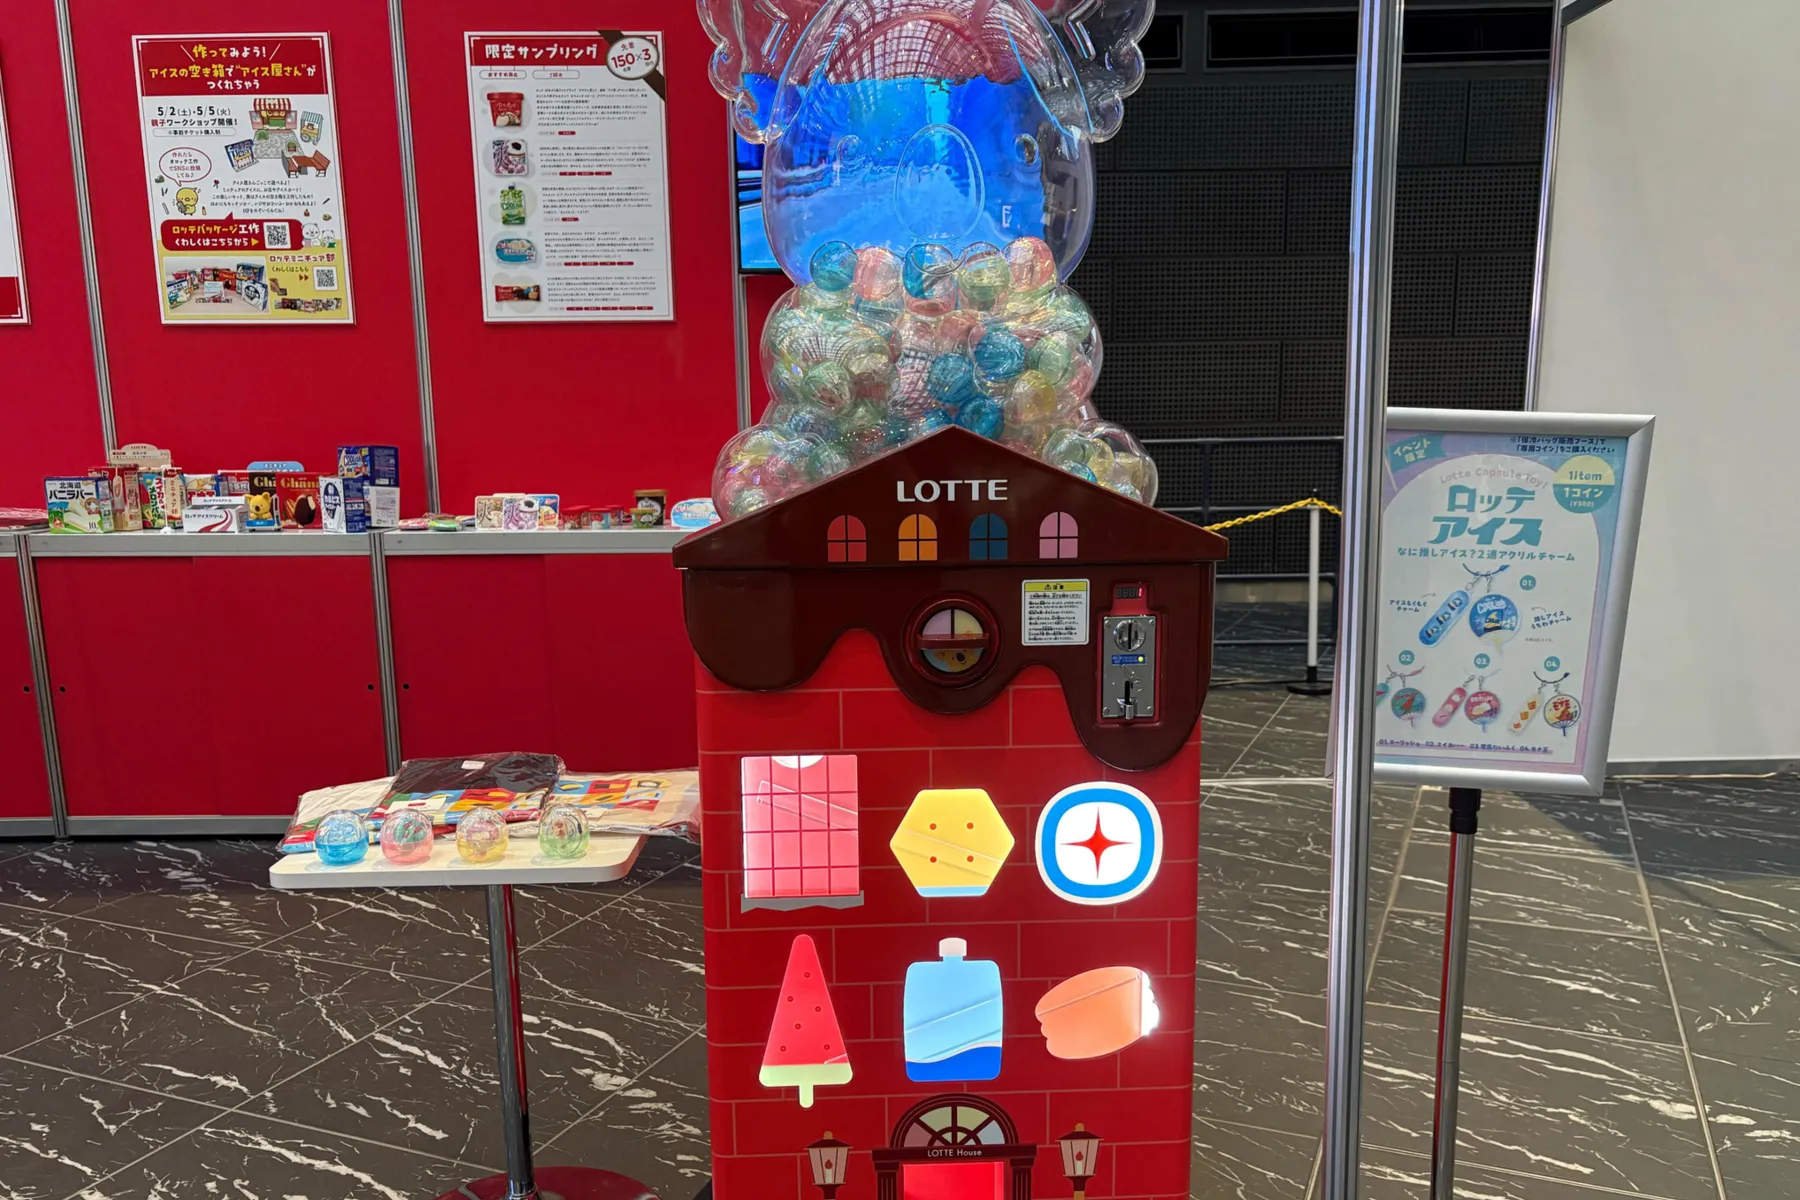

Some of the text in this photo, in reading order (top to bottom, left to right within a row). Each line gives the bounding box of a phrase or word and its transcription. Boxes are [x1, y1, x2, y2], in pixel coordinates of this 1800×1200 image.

[192, 44, 267, 59] 作ってみよう!
[485, 43, 598, 60] 限定サンプリング
[207, 79, 260, 90] つくれちゃう
[172, 223, 260, 235] ロッテパッケージ工作
[175, 238, 249, 247] くわしくはこちらから
[269, 253, 336, 263] ロッテミニチュア部
[1393, 438, 1431, 456] イベント
[49, 489, 94, 500] バニラバー
[897, 479, 1008, 502] LOTTE
[1564, 487, 1604, 498] 1コイン
[1447, 484, 1536, 514] ロッテ
[1427, 516, 1543, 547] アイス
[927, 1148, 982, 1158] LOTTE House
